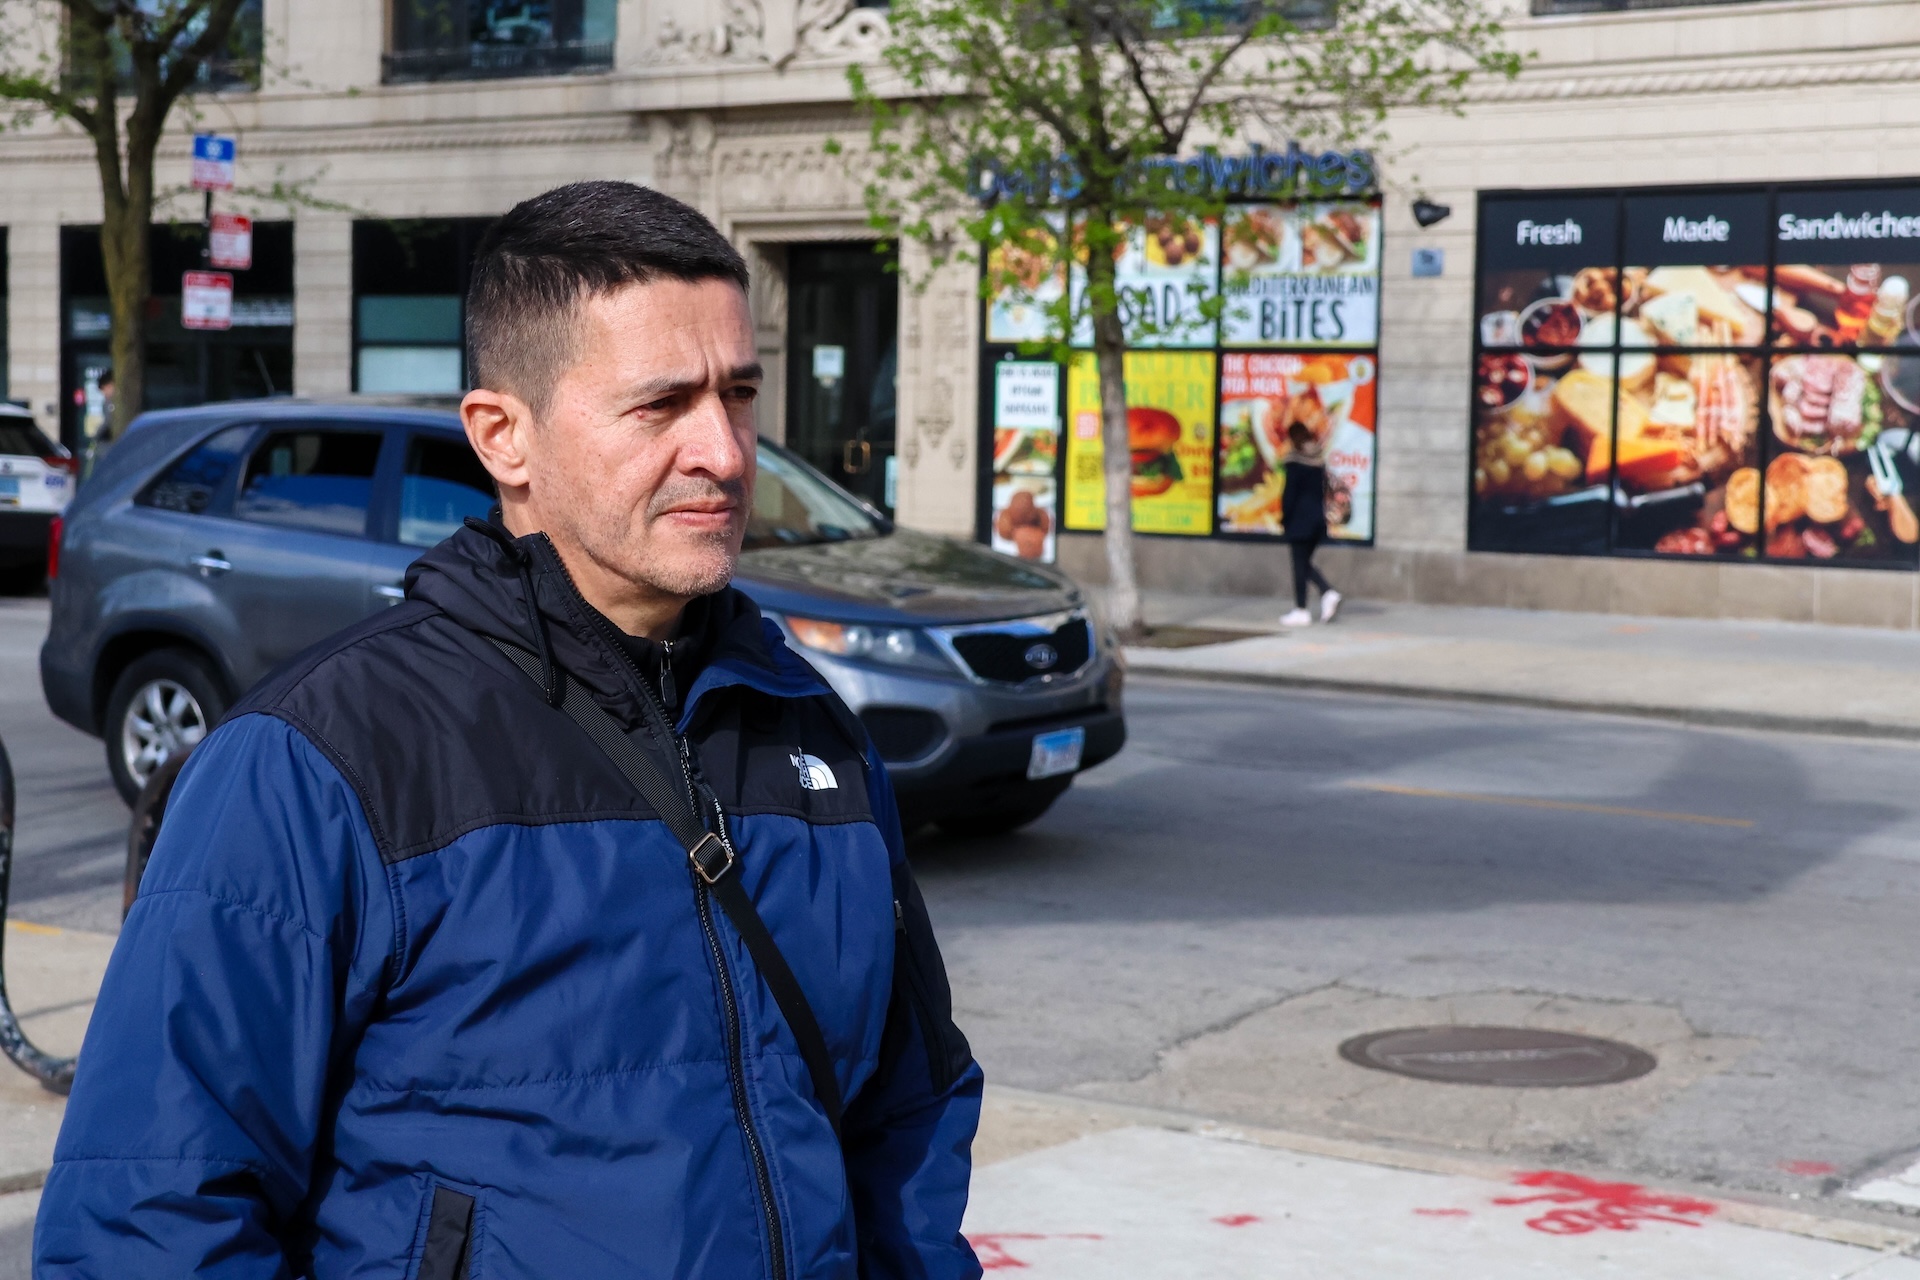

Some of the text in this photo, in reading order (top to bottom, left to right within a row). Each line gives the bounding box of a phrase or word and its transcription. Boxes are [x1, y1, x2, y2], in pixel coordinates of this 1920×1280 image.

[1516, 210, 1920, 245] Fresh Made Sandwiches
[1328, 450, 1370, 471] Only
[718, 813, 726, 839] NORTH
